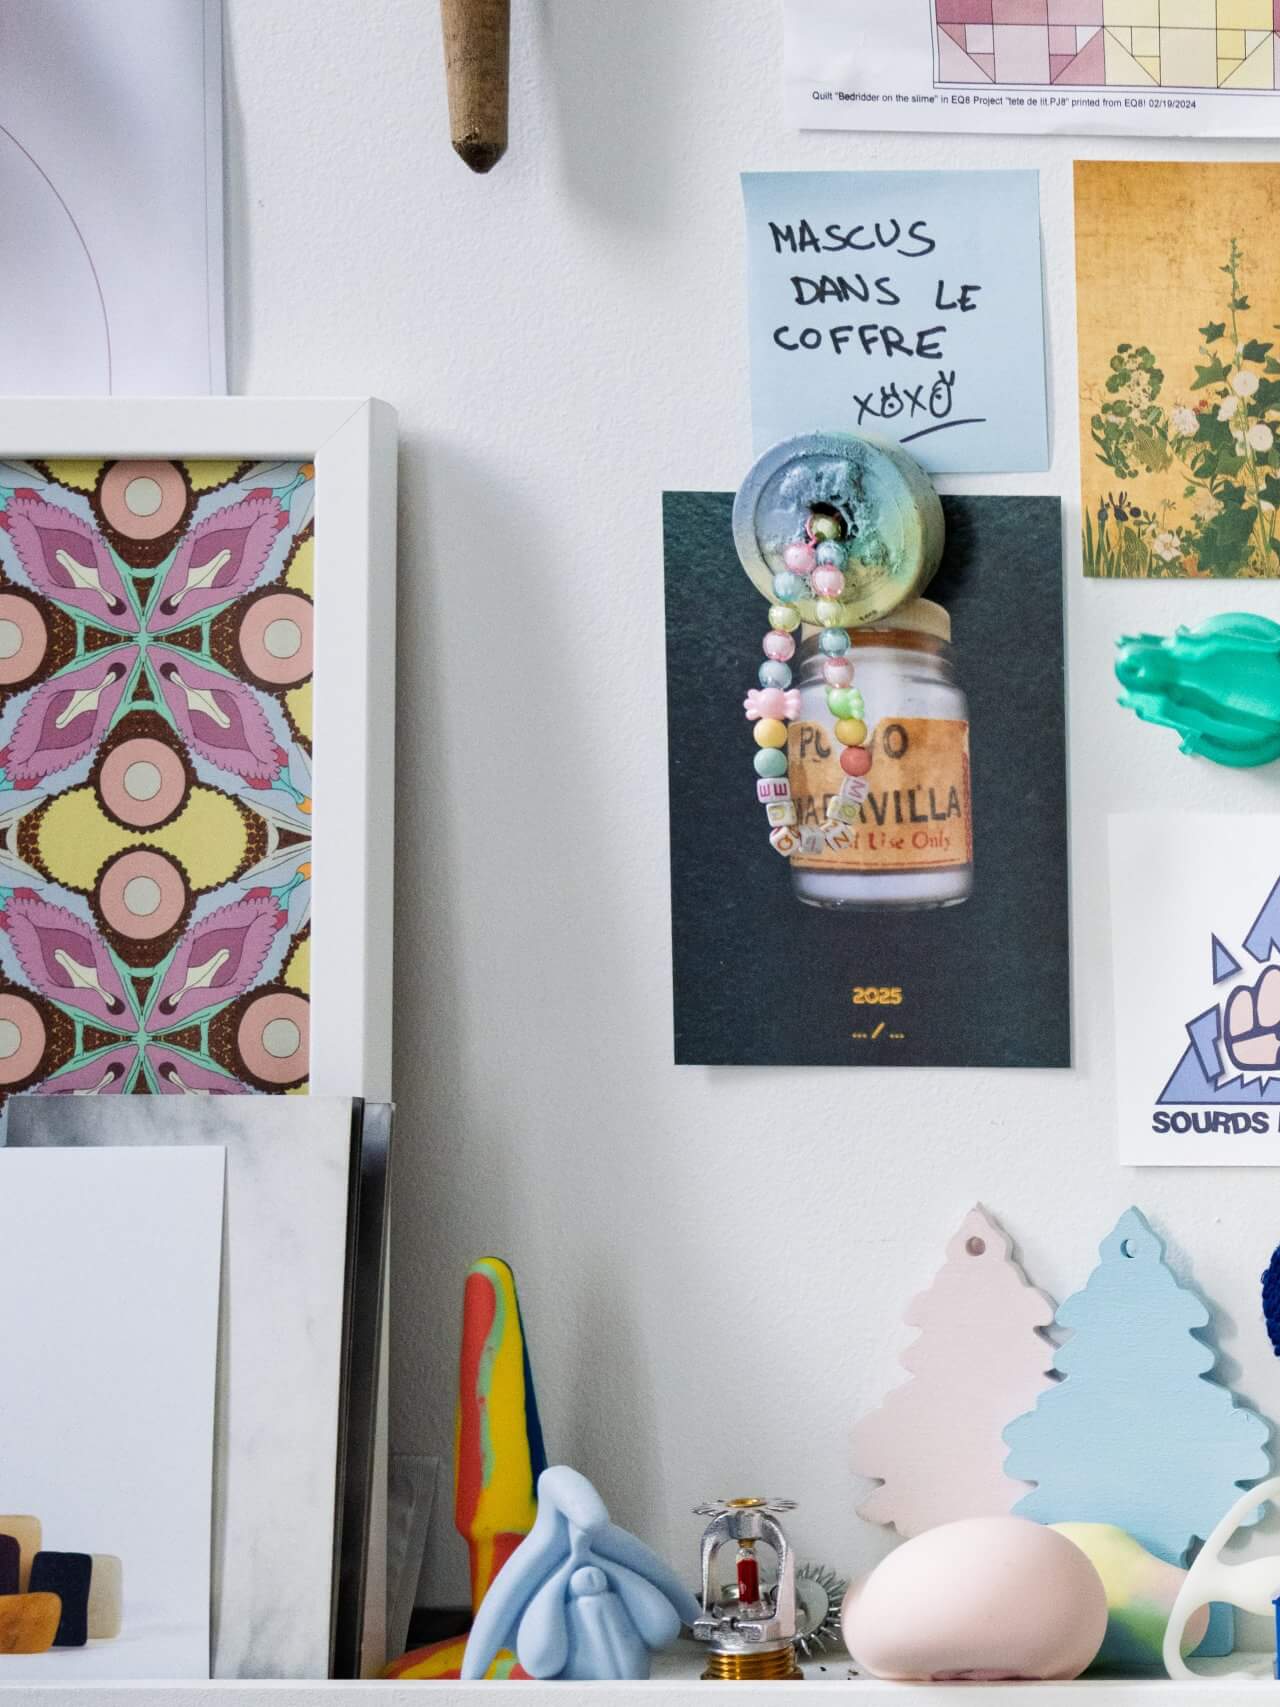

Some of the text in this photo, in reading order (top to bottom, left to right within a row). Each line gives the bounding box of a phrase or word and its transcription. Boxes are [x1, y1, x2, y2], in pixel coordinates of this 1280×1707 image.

[812, 91, 833, 101] Quilt
[895, 94, 909, 103] the
[940, 95, 949, 104] in
[973, 96, 1003, 106] Project
[1027, 97, 1038, 106] de
[1071, 99, 1100, 109] printed
[1102, 99, 1122, 108] from
[1149, 100, 1197, 110] 02/19/2024
[768, 218, 936, 258] MASCUS
[790, 273, 983, 312] DANS LE
[773, 323, 948, 360] COFFRE
[911, 830, 951, 852] Only
[852, 986, 903, 1005] 2025
[1151, 1110, 1270, 1135] SOURDS
